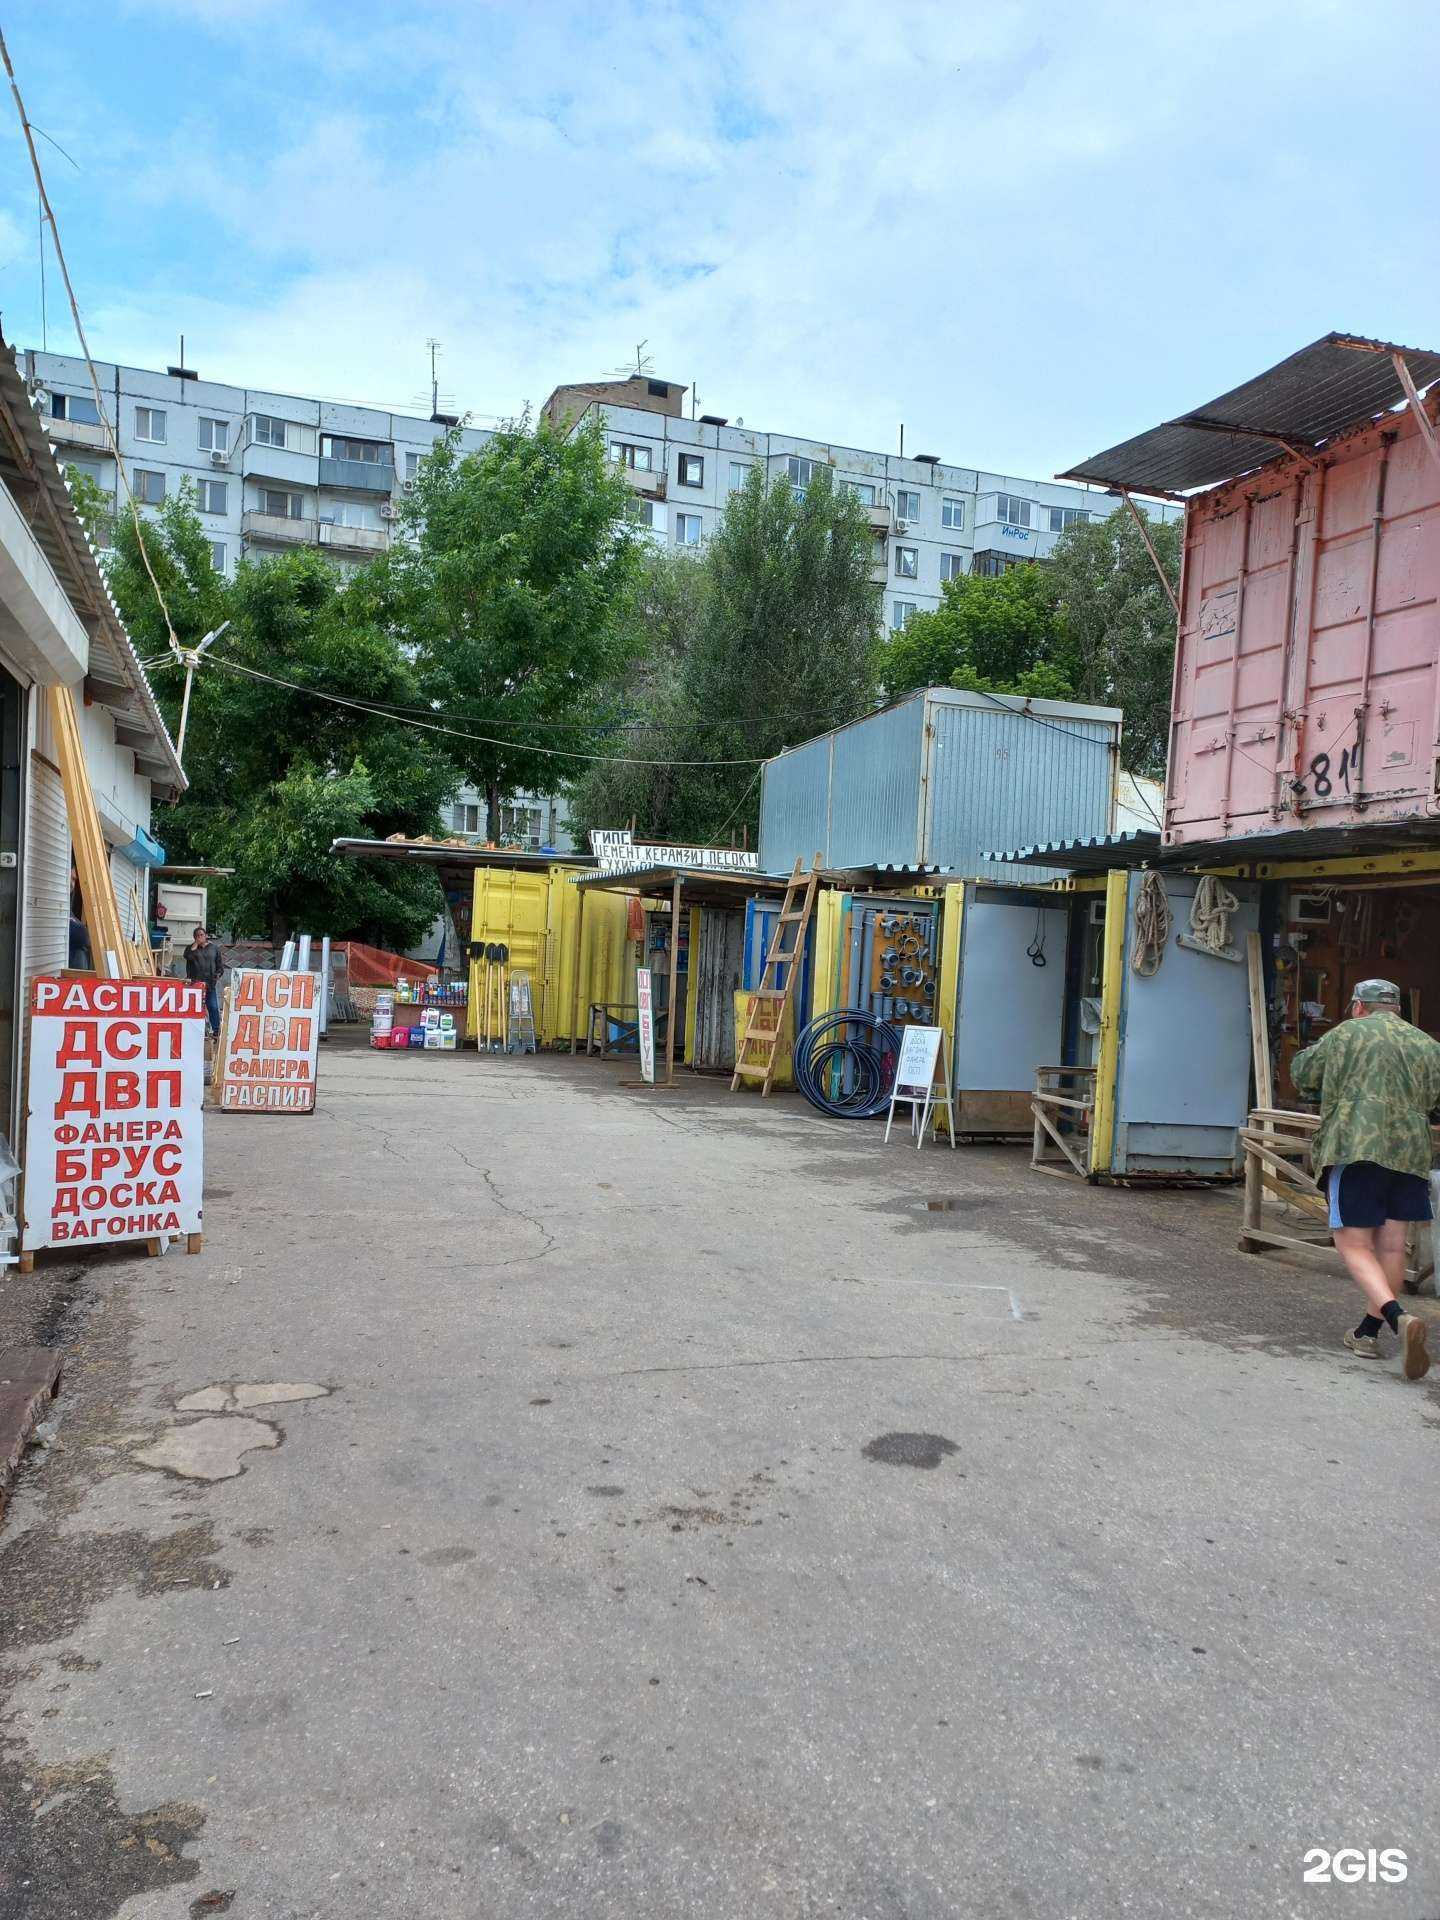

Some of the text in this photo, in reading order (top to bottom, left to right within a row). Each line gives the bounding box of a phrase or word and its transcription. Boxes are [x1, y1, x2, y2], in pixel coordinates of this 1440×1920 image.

[593, 831, 629, 845] ГИПС
[36, 984, 204, 1013] РАСПИЛ
[235, 971, 314, 1013] ДСП
[56, 1021, 183, 1069] ДСП
[230, 1015, 312, 1055] ДВП
[228, 1058, 309, 1079] ФАНЕРА
[54, 1070, 182, 1120] ДВП
[224, 1085, 312, 1107] РАСПИЛ
[54, 1119, 183, 1145] ФАНЕРА
[55, 1143, 182, 1183] БРУС
[51, 1180, 182, 1218] ДОСКА
[51, 1211, 180, 1241] ВАГОНКА
